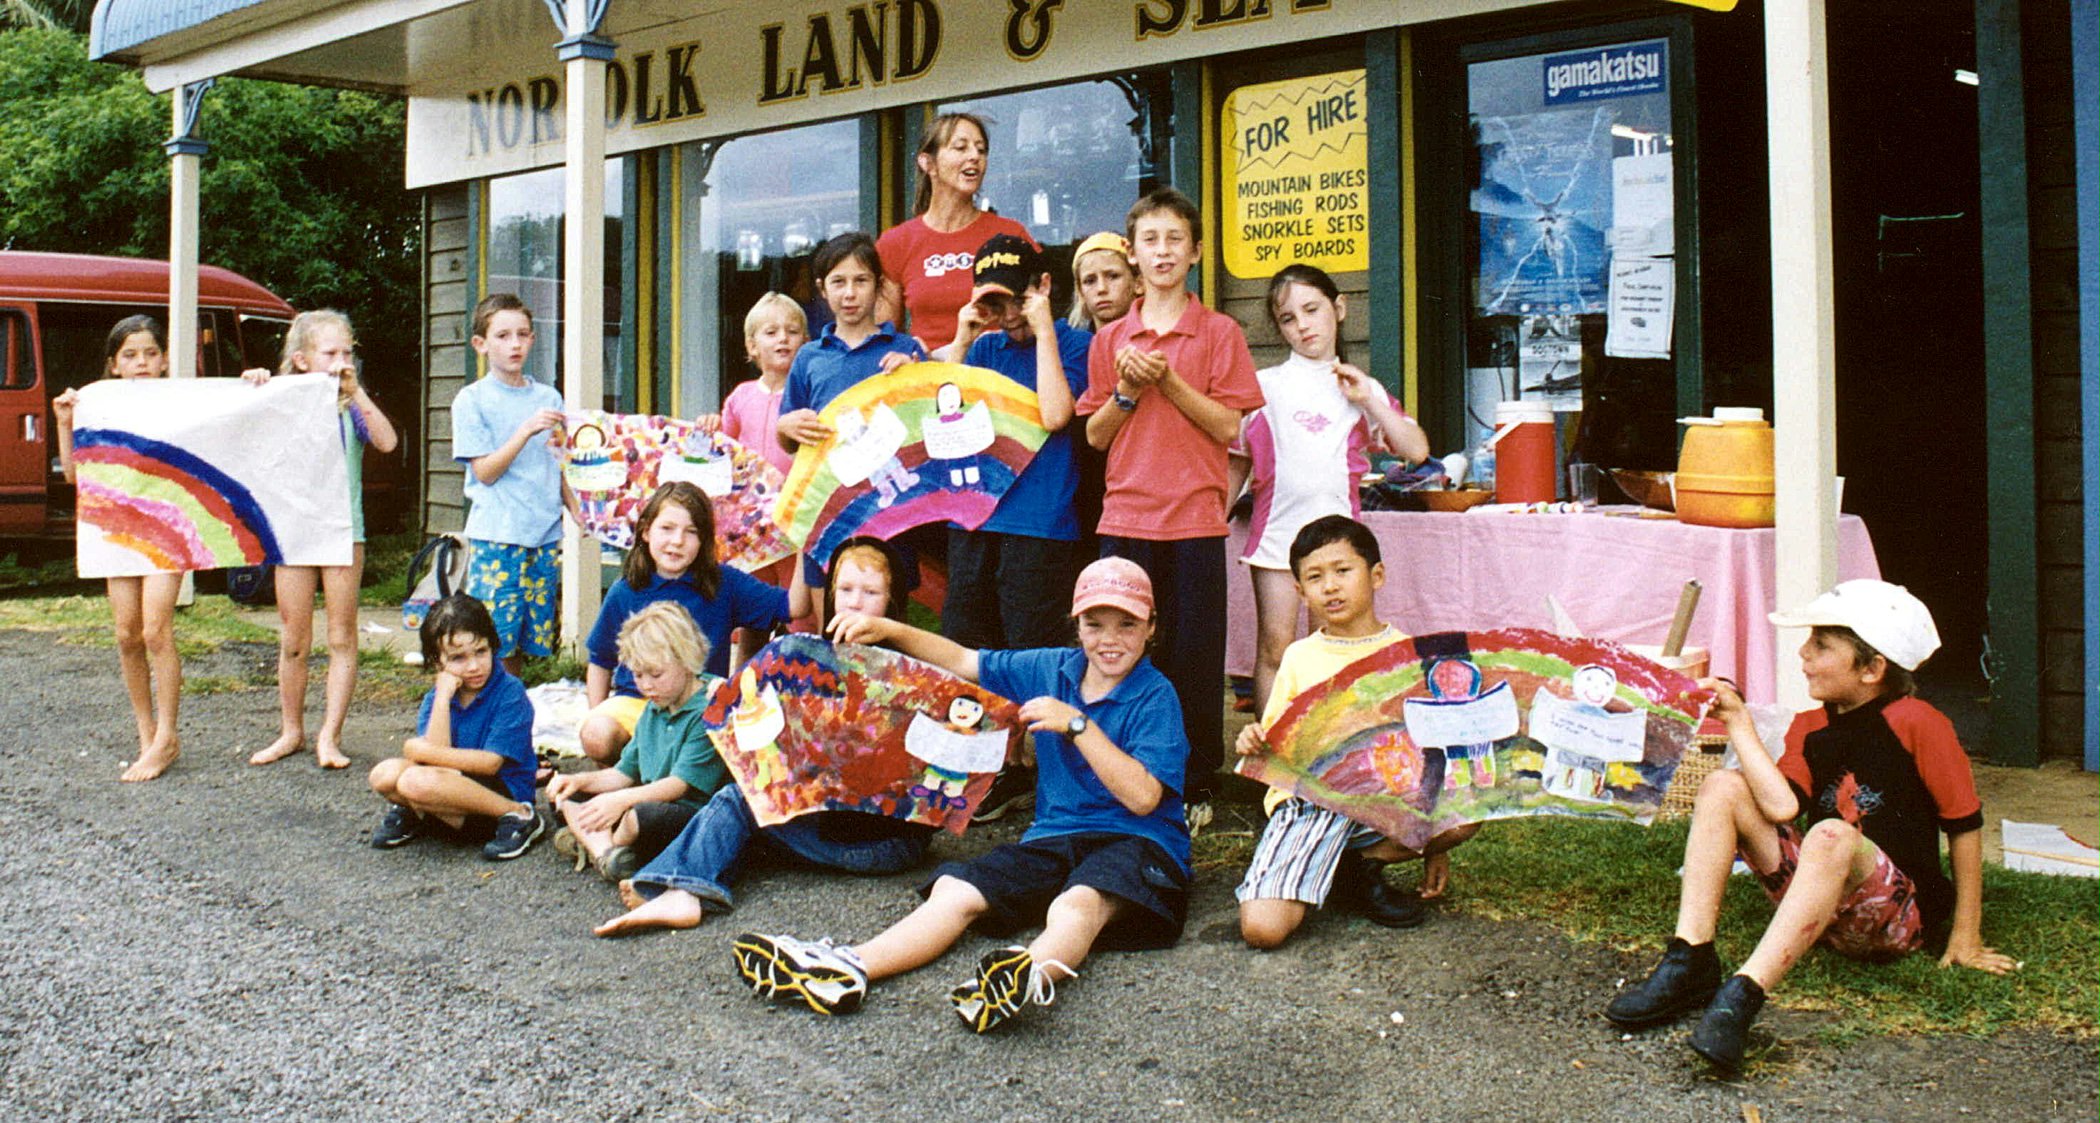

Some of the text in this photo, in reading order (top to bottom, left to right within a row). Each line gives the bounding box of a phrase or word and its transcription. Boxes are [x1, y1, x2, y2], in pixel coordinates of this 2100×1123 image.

[467, 0, 1063, 157] NOROLK LAND &
[1547, 51, 1659, 97] gamakatsu
[1245, 89, 1358, 158] FOR HIRE
[1238, 169, 1366, 198] MOUNTAIN BIKES
[1247, 192, 1359, 219] FISHING RODS
[1242, 214, 1365, 242] SNORKLE SETS
[1255, 238, 1355, 261] SPY BOARDS
